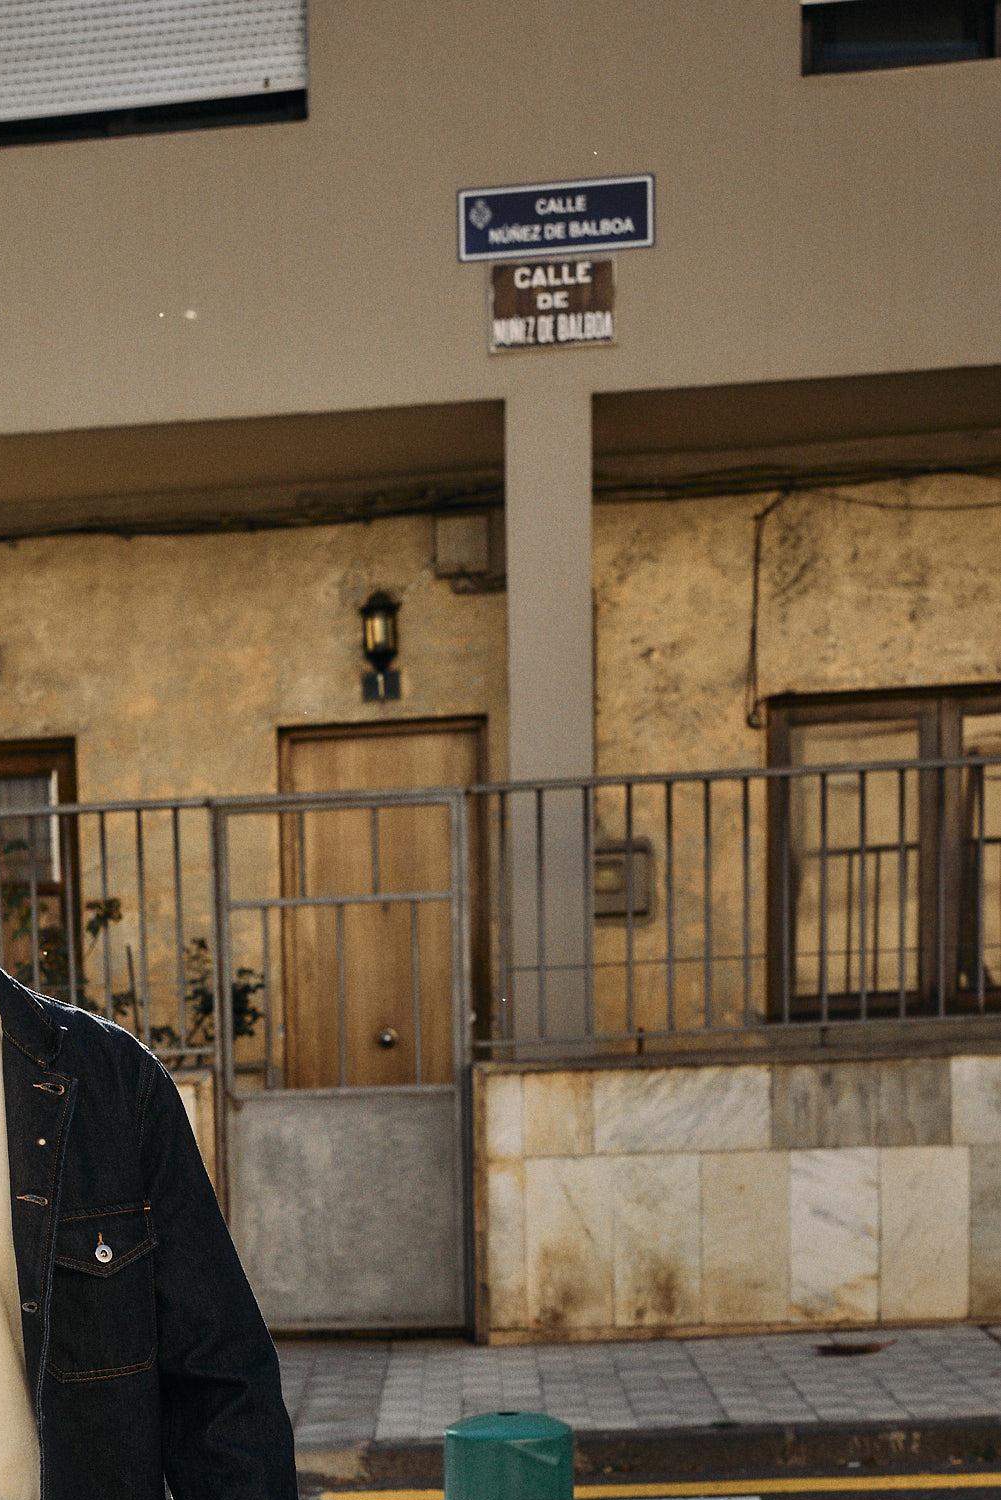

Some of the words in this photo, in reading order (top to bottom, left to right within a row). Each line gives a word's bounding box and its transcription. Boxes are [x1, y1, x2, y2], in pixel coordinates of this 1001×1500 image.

[535, 194, 587, 216] CALLE
[544, 222, 566, 241] DE
[568, 216, 636, 239] BALBOA
[514, 261, 592, 289] CALLE
[536, 291, 569, 310] DE
